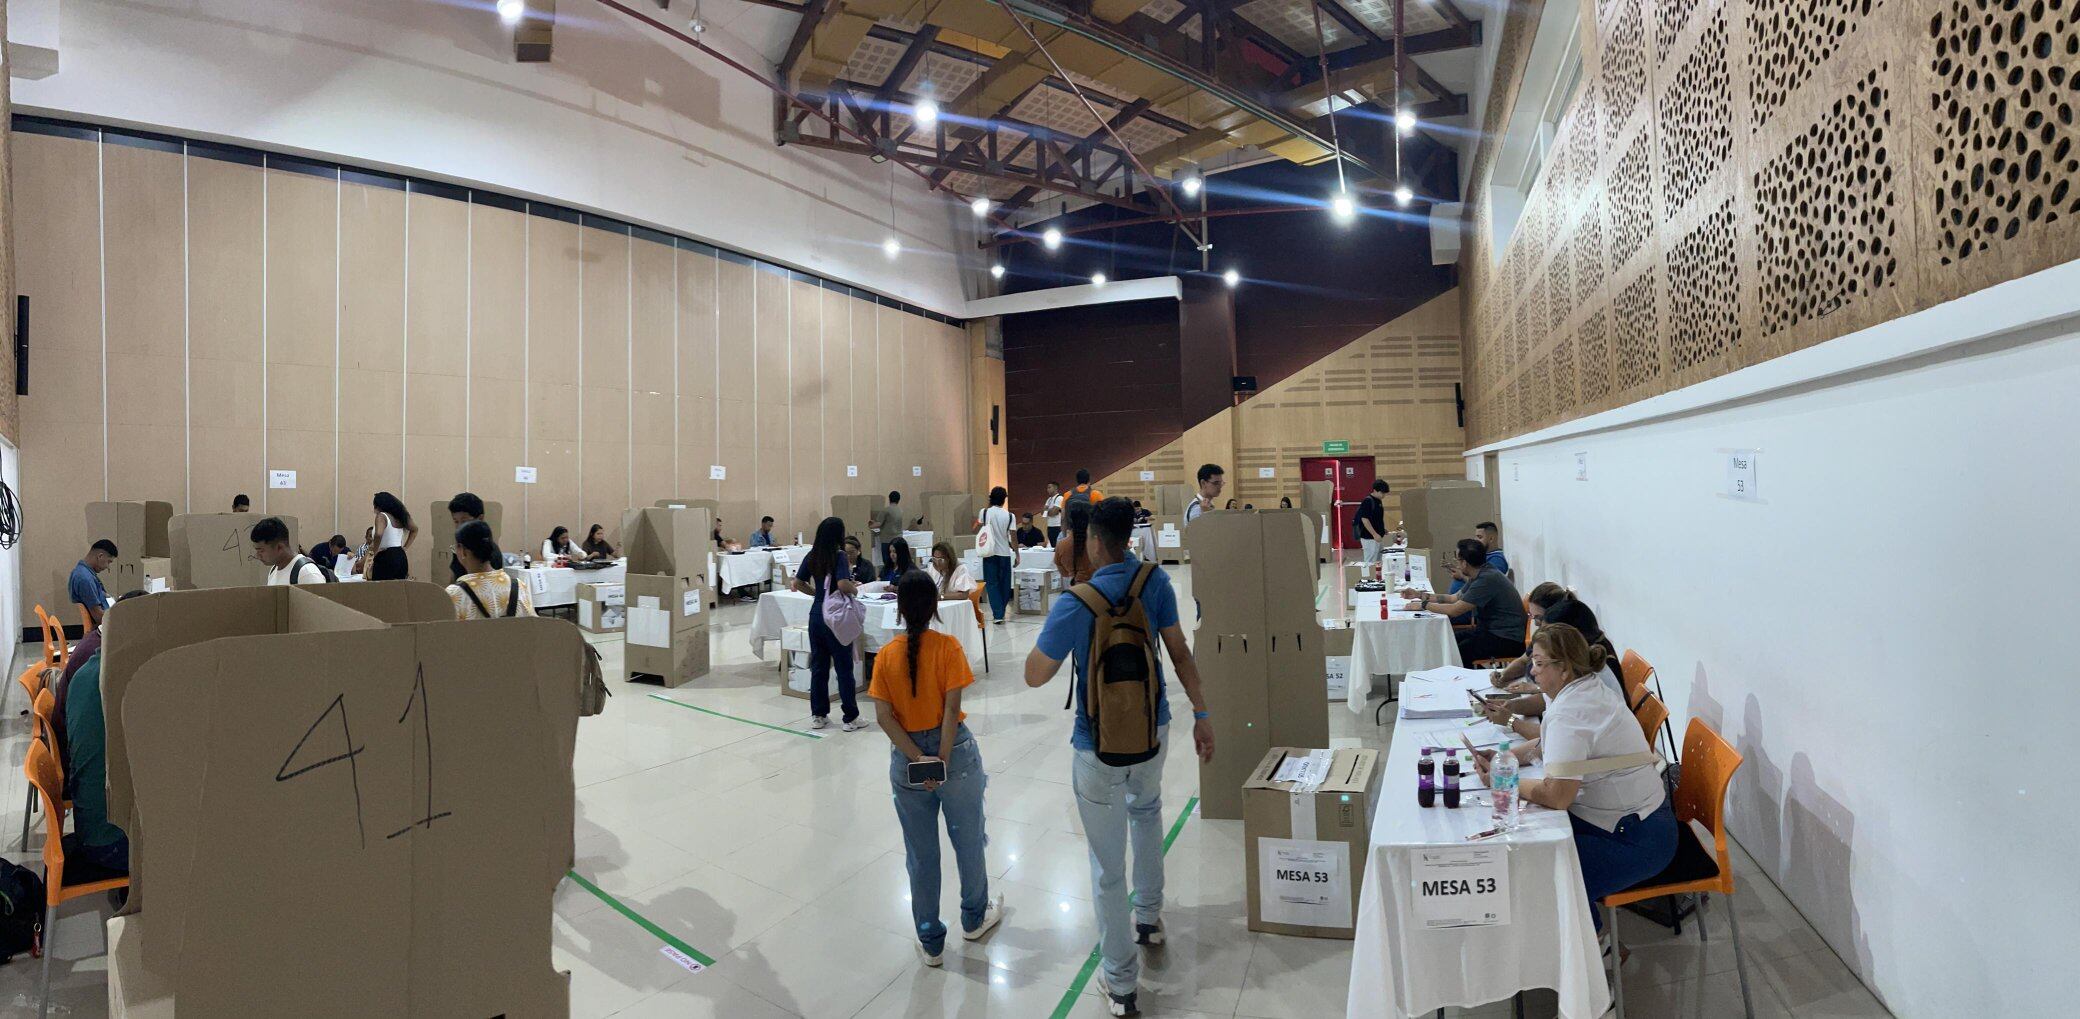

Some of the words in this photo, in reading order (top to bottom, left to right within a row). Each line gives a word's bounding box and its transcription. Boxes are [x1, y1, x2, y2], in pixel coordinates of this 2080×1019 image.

[1733, 457, 1747, 470] Mesa
[1737, 479, 1744, 492] 53
[276, 661, 452, 850] 41
[1276, 869, 1310, 883] MESA
[1314, 872, 1328, 883] 53
[1422, 879, 1471, 897] MESA
[1476, 877, 1497, 894] 53
